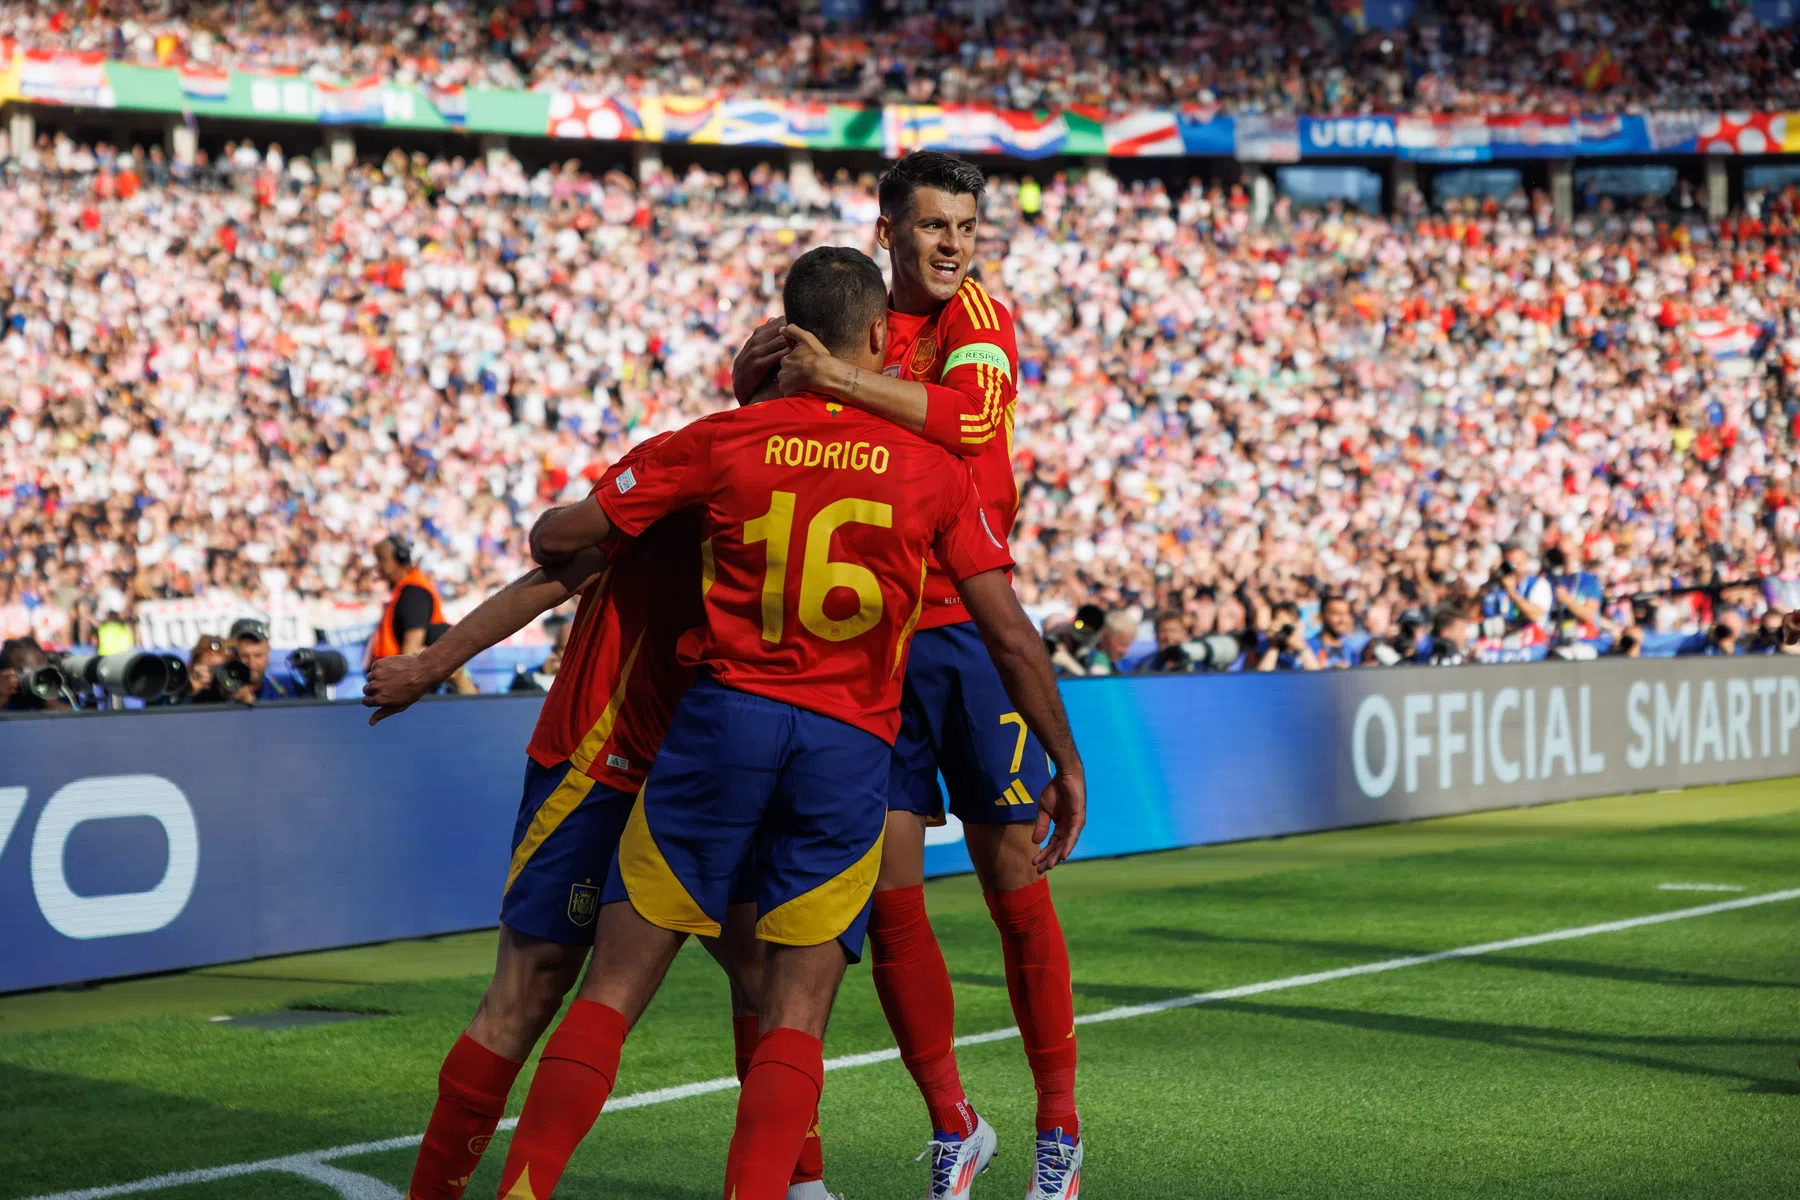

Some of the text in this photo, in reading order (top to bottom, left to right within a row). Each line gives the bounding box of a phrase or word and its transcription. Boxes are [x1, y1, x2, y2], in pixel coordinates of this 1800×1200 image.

[1310, 120, 1395, 148] UEFA
[965, 351, 1006, 369] RESPECT
[764, 434, 890, 475] RODRIGO
[743, 490, 892, 643] 16
[1000, 711, 1028, 774] 7
[1352, 675, 1800, 798] OFFICIAL SMARTP
